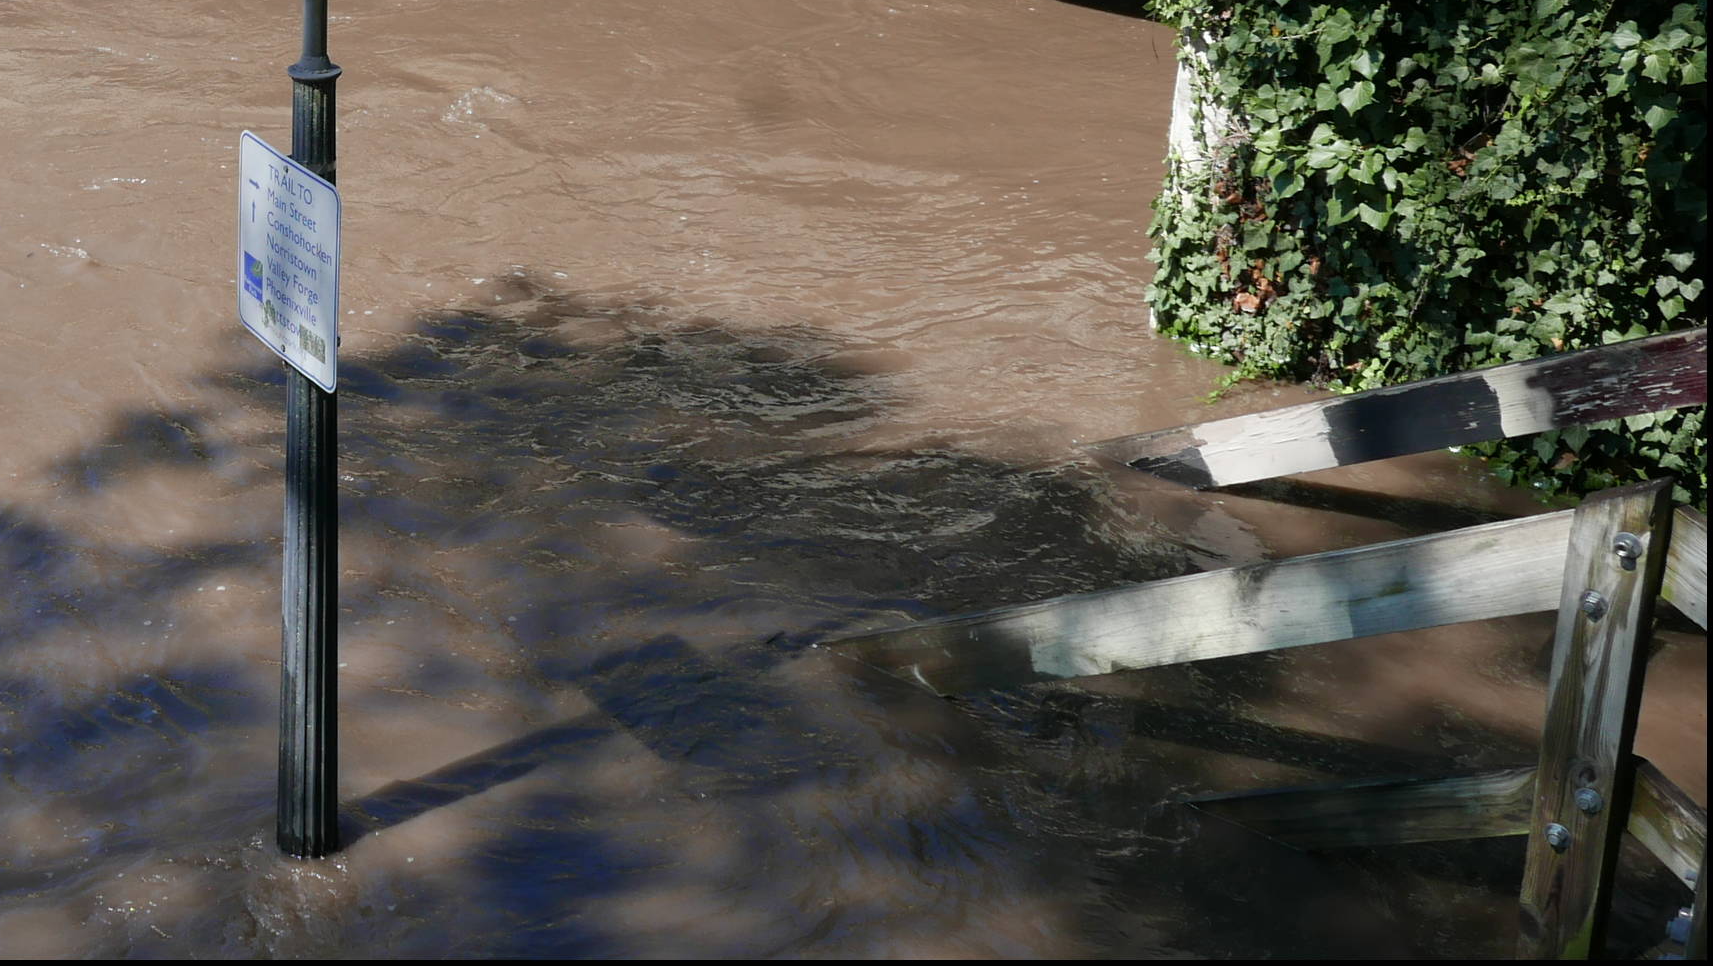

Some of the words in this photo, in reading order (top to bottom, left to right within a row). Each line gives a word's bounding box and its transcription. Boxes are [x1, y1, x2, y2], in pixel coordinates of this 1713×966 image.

[269, 164, 296, 196] TRAIL
[297, 183, 313, 205] TO
[267, 188, 287, 213] Main
[289, 202, 317, 233] Street
[266, 233, 317, 281] Norristown
[267, 211, 332, 266] Conshohocken
[266, 277, 317, 326] Phoenixville
[267, 254, 290, 288] Valley
[293, 274, 319, 305] Forge
